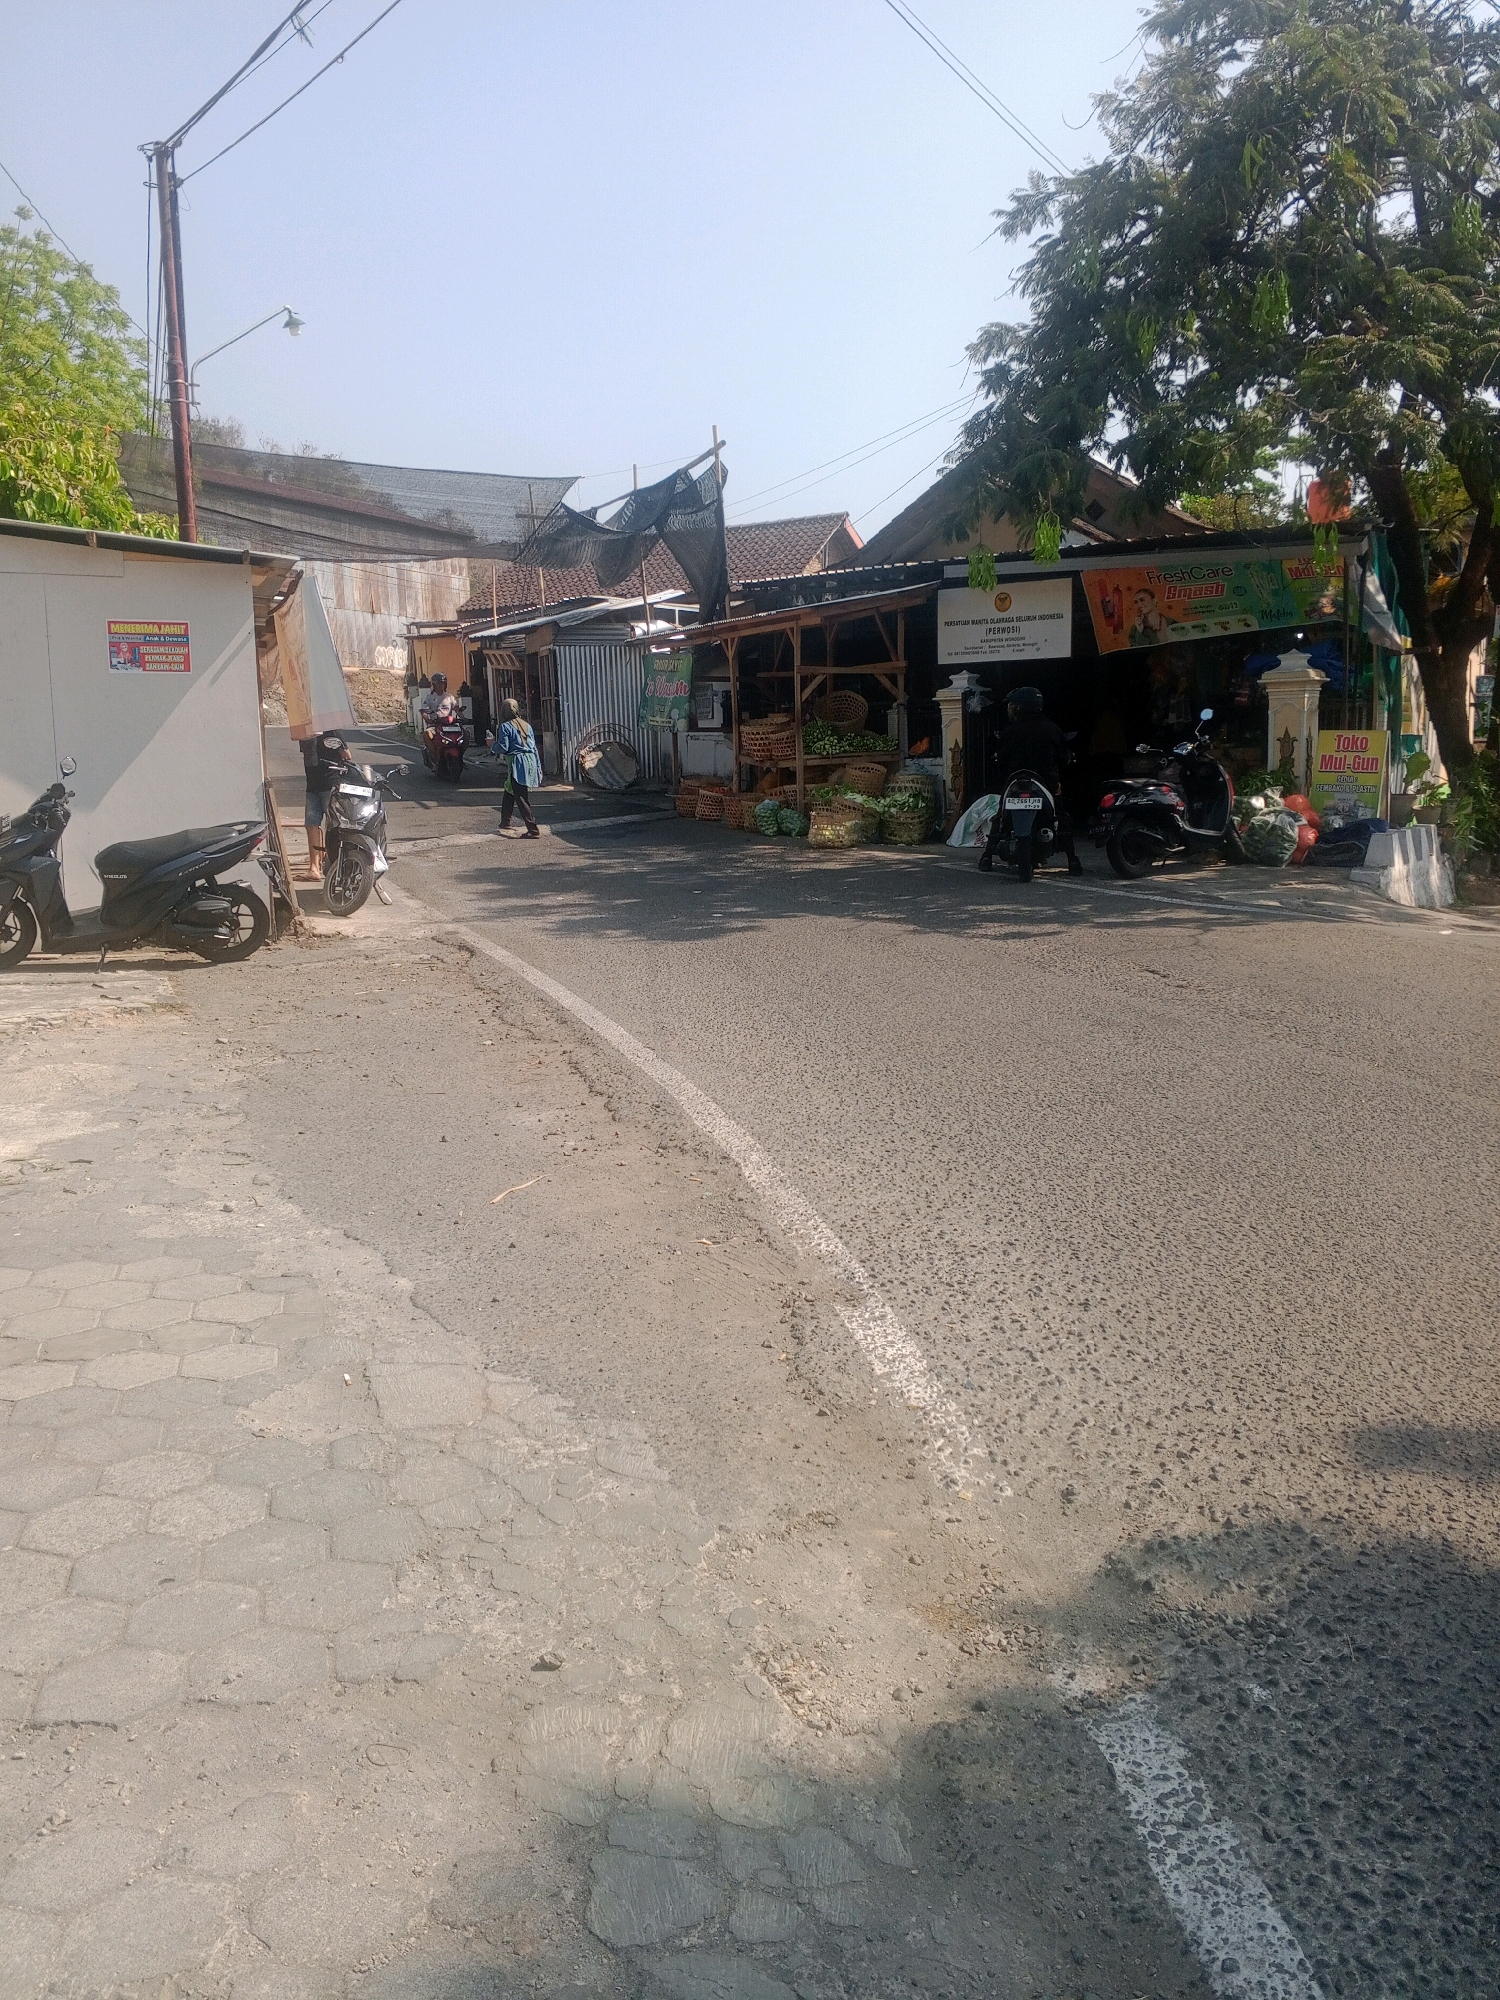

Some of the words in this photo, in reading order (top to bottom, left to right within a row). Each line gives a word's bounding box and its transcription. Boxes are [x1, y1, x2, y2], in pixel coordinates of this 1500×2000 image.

[1145, 566, 1234, 585] FreshCare
[1165, 581, 1227, 600] Smash
[944, 619, 971, 627] PERSATUAN
[990, 616, 1015, 625] OLAHRAGA
[1015, 615, 1037, 623] SELURUH
[1037, 613, 1064, 621] INDONESIA
[111, 623, 160, 634] MENERIMA
[160, 624, 186, 635] JAHIT
[985, 626, 1021, 637] (PERWOSI)
[1335, 733, 1369, 751] Toko
[1319, 753, 1380, 773] Mul-Gun
[1337, 775, 1354, 783] SEDIA
[1316, 784, 1345, 793] SEMBAKO
[1352, 785, 1377, 794] PLASTIK
